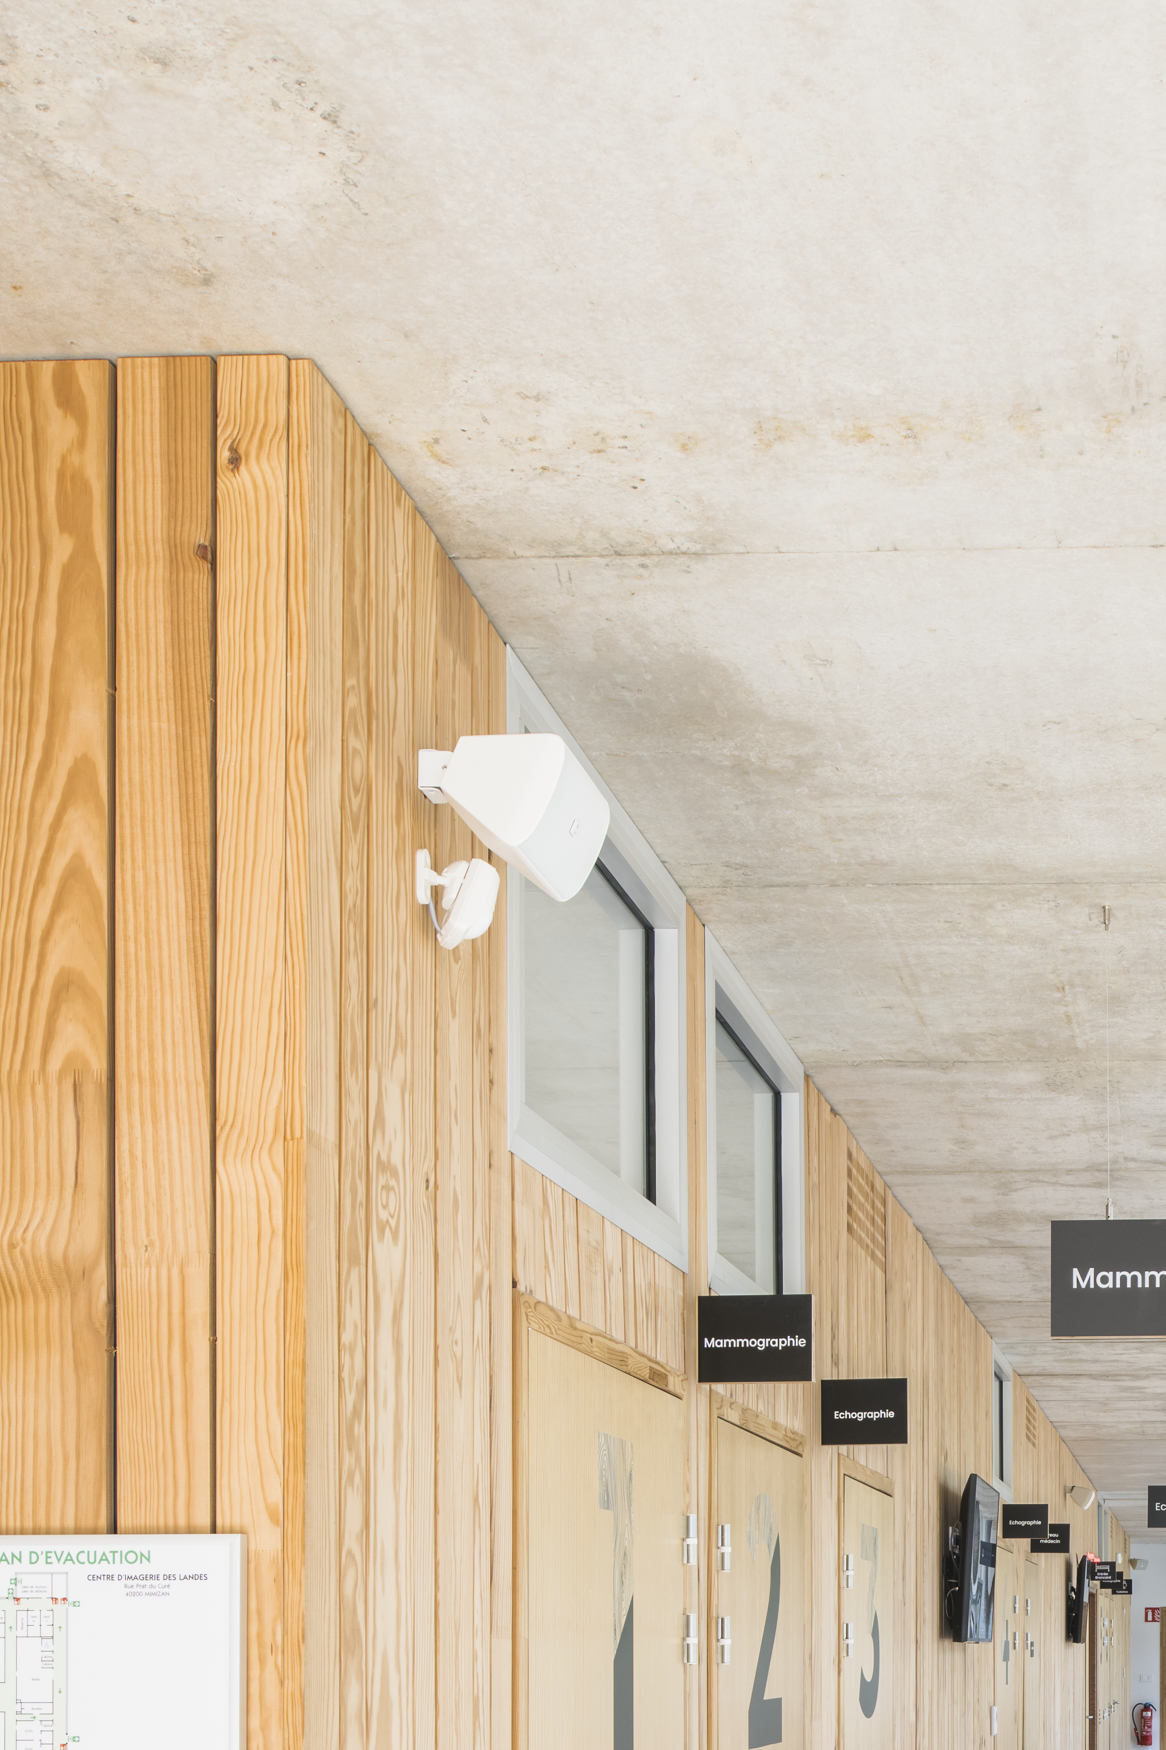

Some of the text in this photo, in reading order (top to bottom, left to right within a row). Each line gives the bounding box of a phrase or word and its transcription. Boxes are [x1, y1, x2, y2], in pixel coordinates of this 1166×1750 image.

[703, 1335, 807, 1350] Mammographie
[834, 1409, 895, 1421] Echographie
[28, 1550, 151, 1565] D'EVACUATION
[746, 1493, 783, 1750] 2
[858, 1523, 880, 1719] 3
